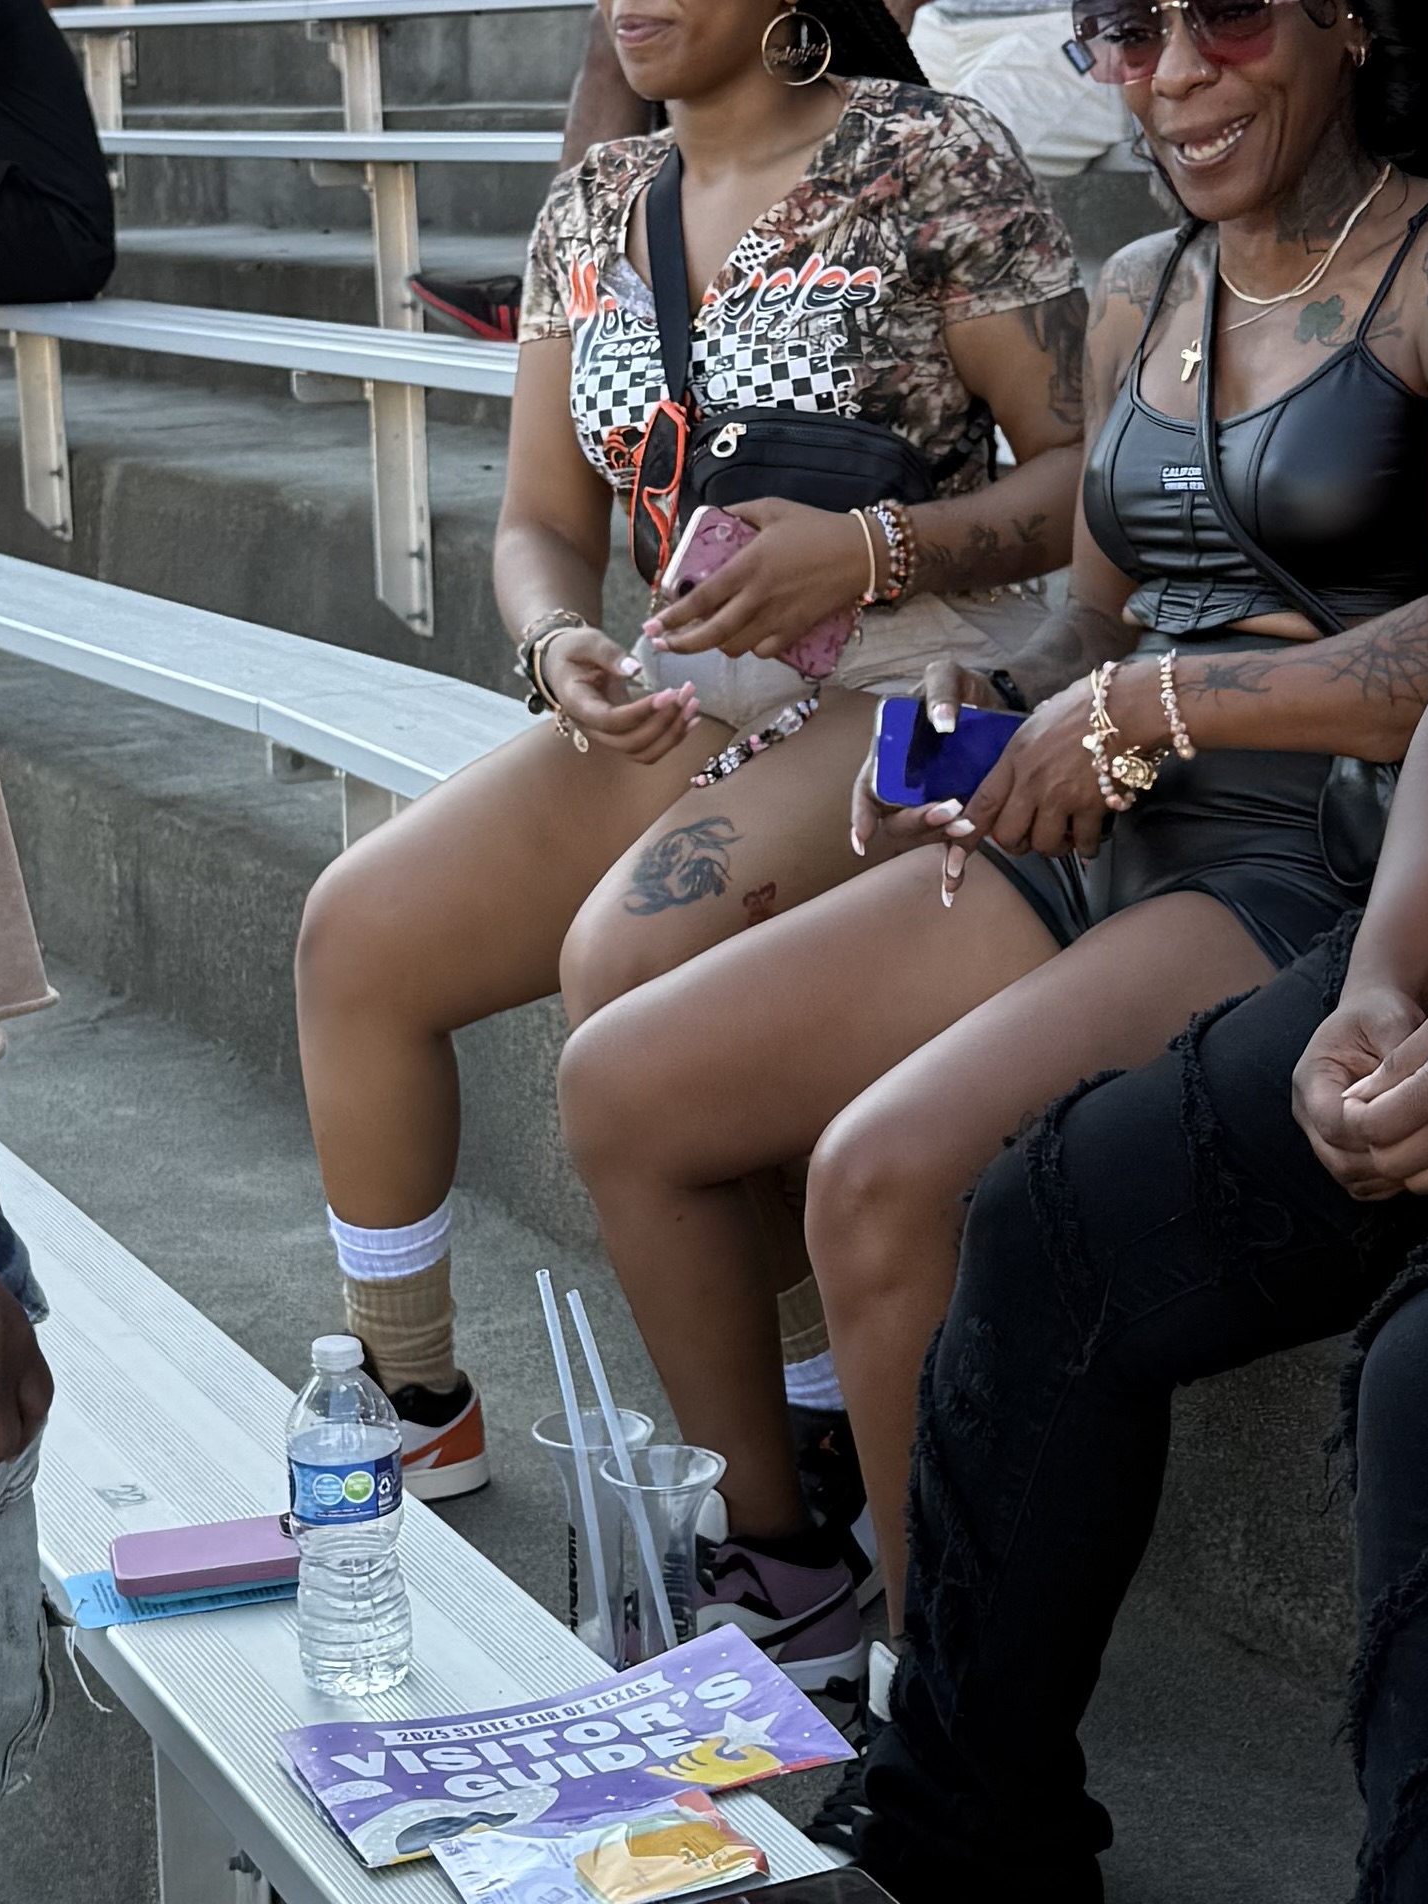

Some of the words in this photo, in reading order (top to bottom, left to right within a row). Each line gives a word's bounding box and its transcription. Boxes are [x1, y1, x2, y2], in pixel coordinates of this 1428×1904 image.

[397, 1727, 448, 1743] 2025
[452, 1717, 514, 1737] STATE
[515, 1708, 561, 1727] FAIR
[565, 1700, 586, 1718] OF
[444, 1728, 703, 1799] GUIDE
